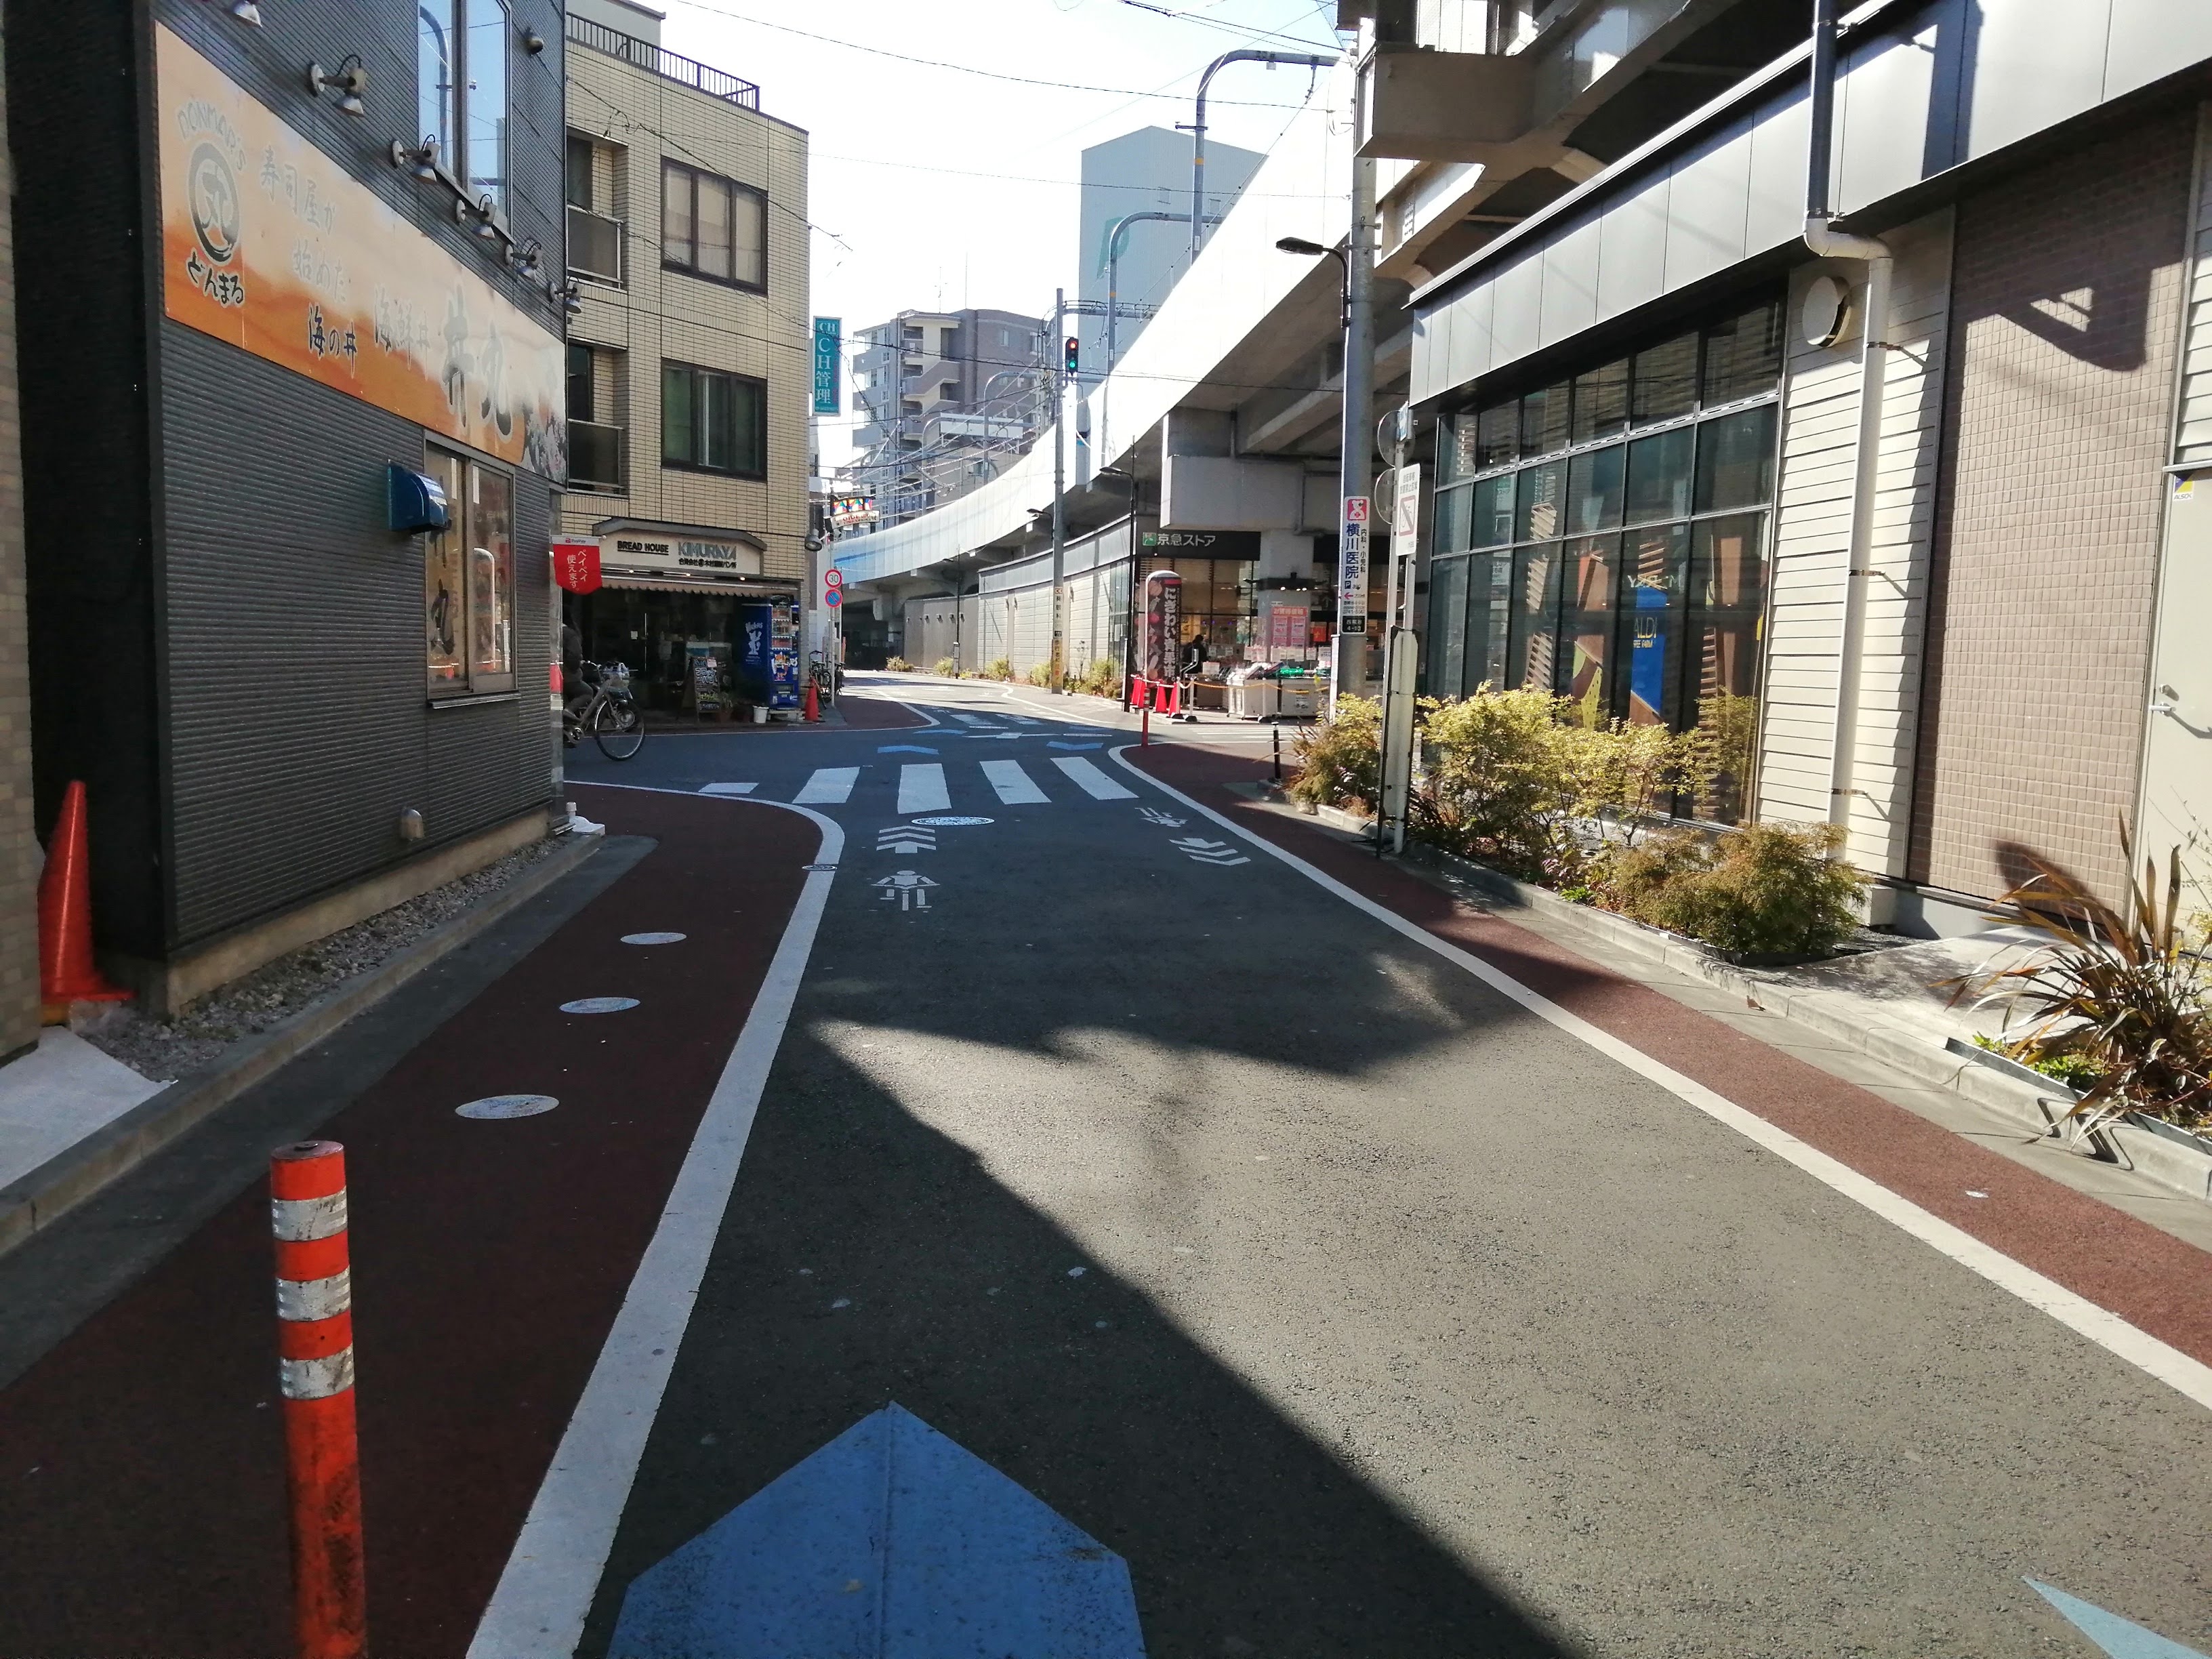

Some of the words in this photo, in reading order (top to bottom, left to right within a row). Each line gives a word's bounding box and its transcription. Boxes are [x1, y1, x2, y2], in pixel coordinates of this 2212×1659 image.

[186, 251, 244, 304] どんまる
[308, 305, 358, 377] 海の丼
[441, 283, 512, 437] 丼丸
[815, 337, 832, 405] CH管理
[617, 541, 642, 551] BREAD
[644, 544, 669, 553] HOUSE
[678, 542, 737, 560] KIMURAYA
[1157, 533, 1216, 547] 京急ストア
[1345, 523, 1360, 579] 横川医院
[577, 549, 588, 581] ペイペイ
[828, 575, 839, 583] 30
